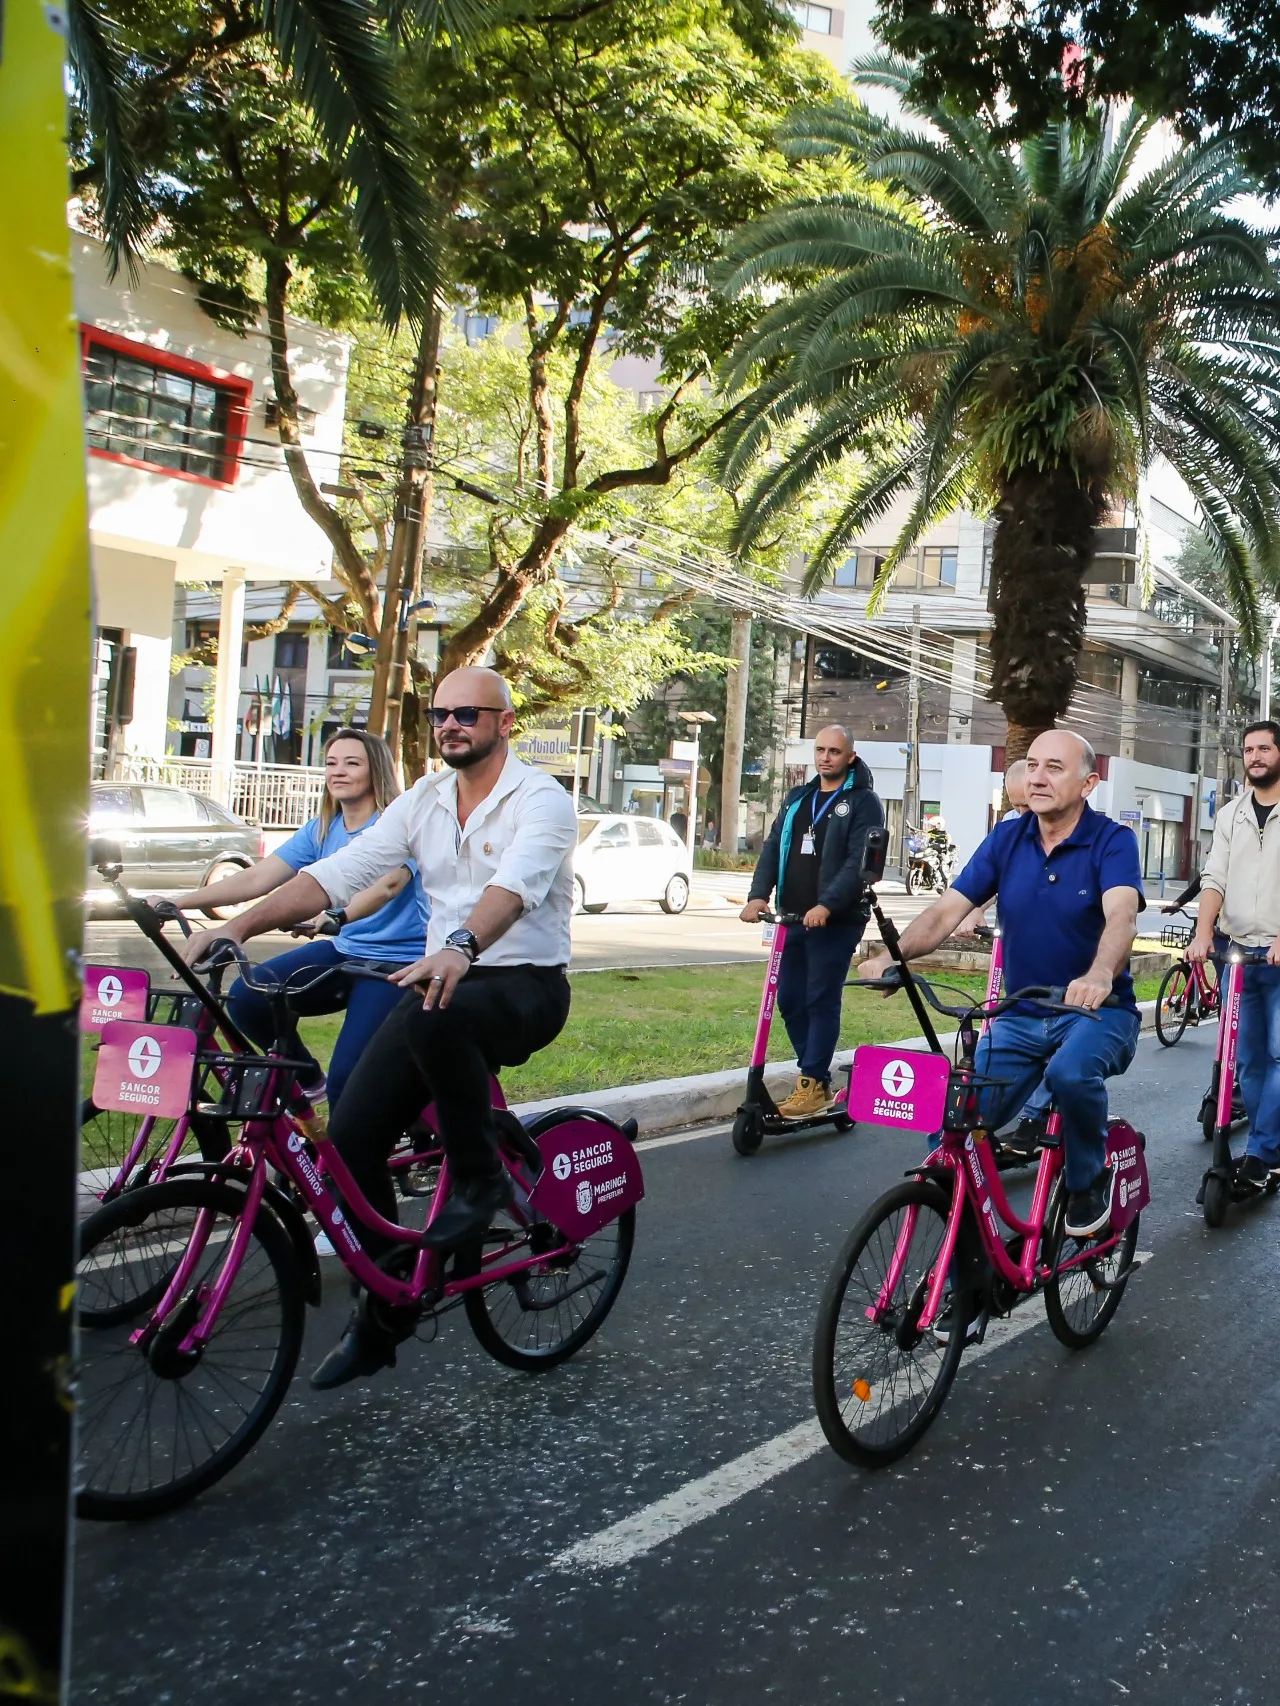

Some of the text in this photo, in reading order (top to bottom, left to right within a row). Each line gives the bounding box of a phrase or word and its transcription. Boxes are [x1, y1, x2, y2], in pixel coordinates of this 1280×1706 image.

[92, 1008, 123, 1018] SANCOR
[120, 1081, 161, 1095] SANCOR
[118, 1091, 160, 1105] SEGUROS
[874, 1098, 914, 1112] SANCOR
[872, 1107, 914, 1121] SEGUROS
[572, 1141, 613, 1162] SANCOR
[1119, 1145, 1136, 1160] SANCOR
[574, 1152, 614, 1174] SEGUROS
[968, 1152, 983, 1189] SEGUROS
[1119, 1156, 1137, 1171] SEGUROS
[296, 1154, 324, 1196] SEGUROS
[594, 1171, 627, 1197] MARINGÁ
[597, 1187, 624, 1204] PREFEITURA
